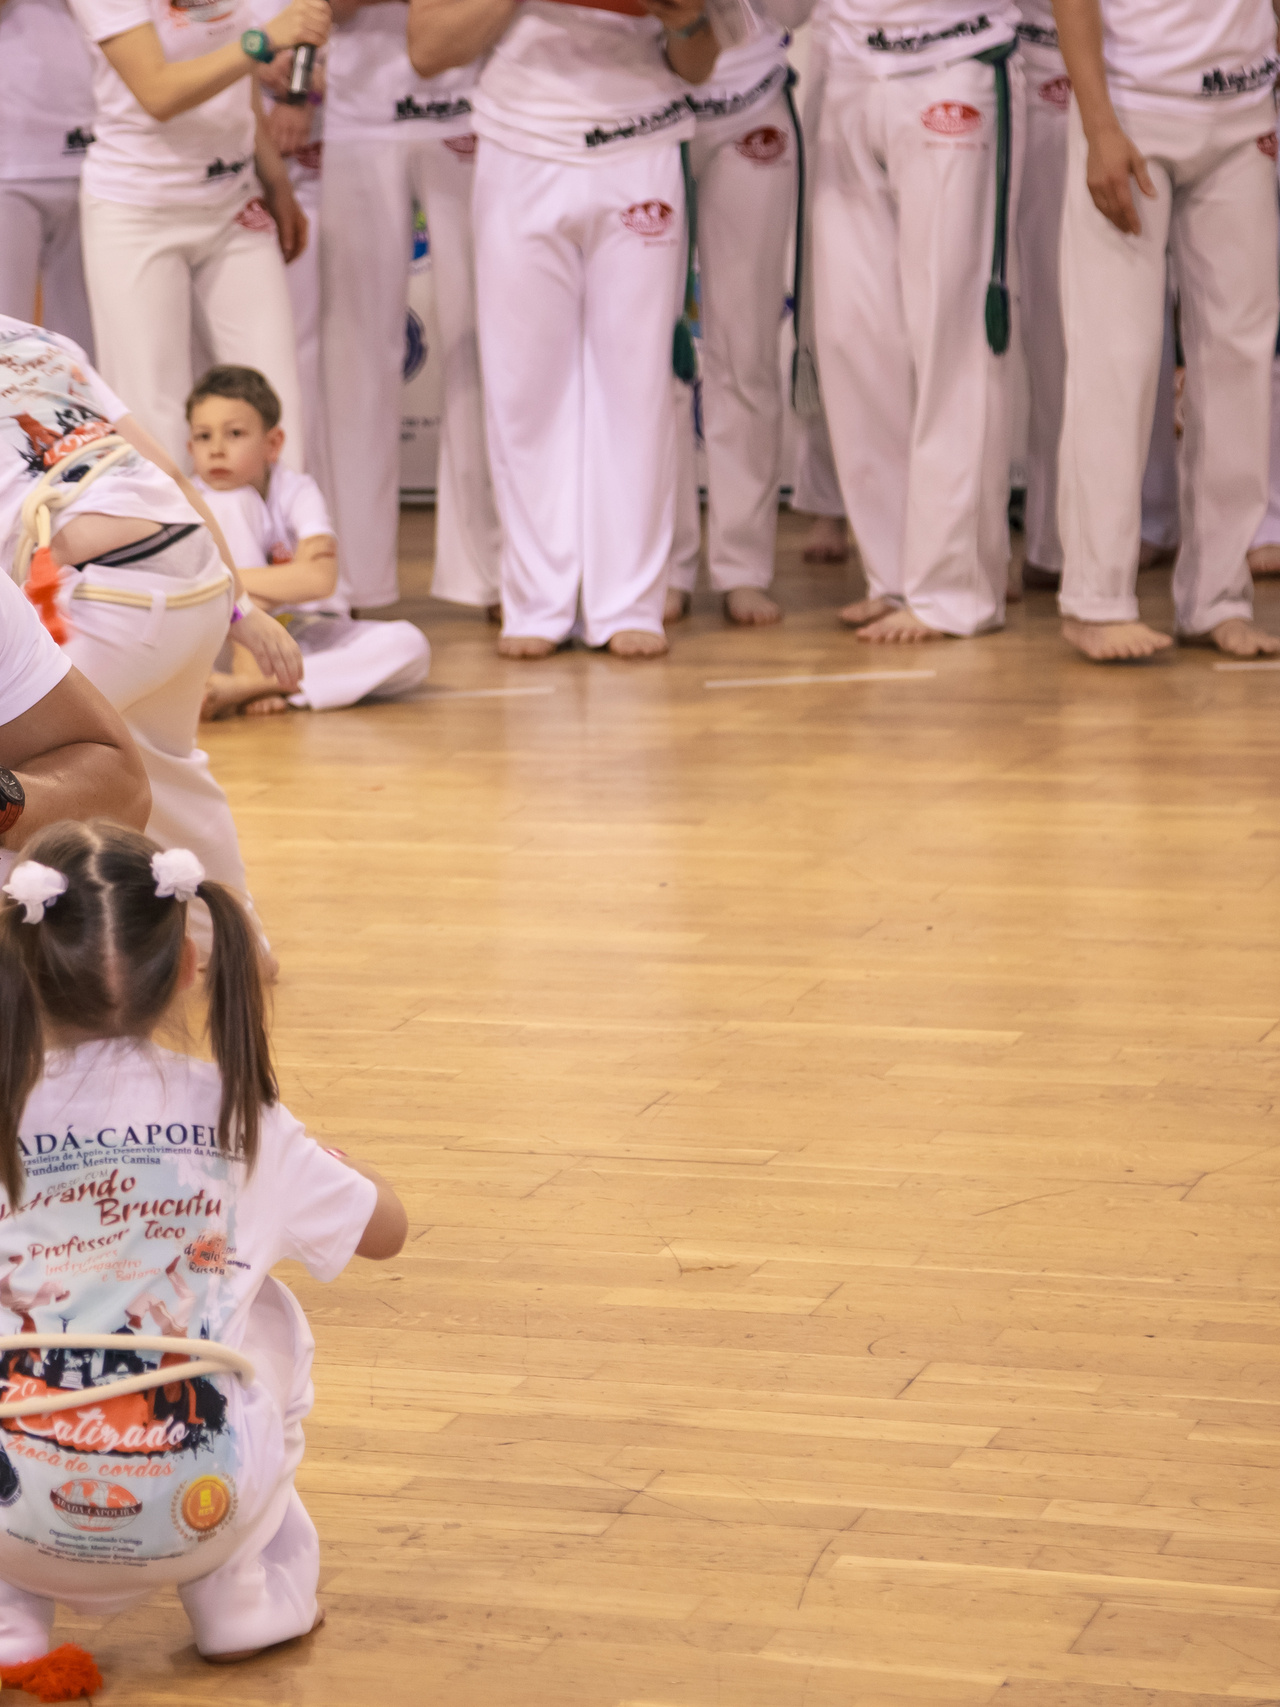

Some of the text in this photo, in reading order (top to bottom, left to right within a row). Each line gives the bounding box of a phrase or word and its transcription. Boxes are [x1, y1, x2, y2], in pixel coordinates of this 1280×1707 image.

[22, 1154, 60, 1167] rasileira
[63, 1152, 73, 1160] de
[194, 1147, 204, 1156] da
[83, 1157, 118, 1168] Mestre
[121, 1155, 160, 1165] Camisa
[94, 1189, 222, 1226] Brucutu
[28, 1220, 186, 1260] Professor Teco
[65, 1455, 90, 1473] de
[98, 1457, 175, 1477] cordas
